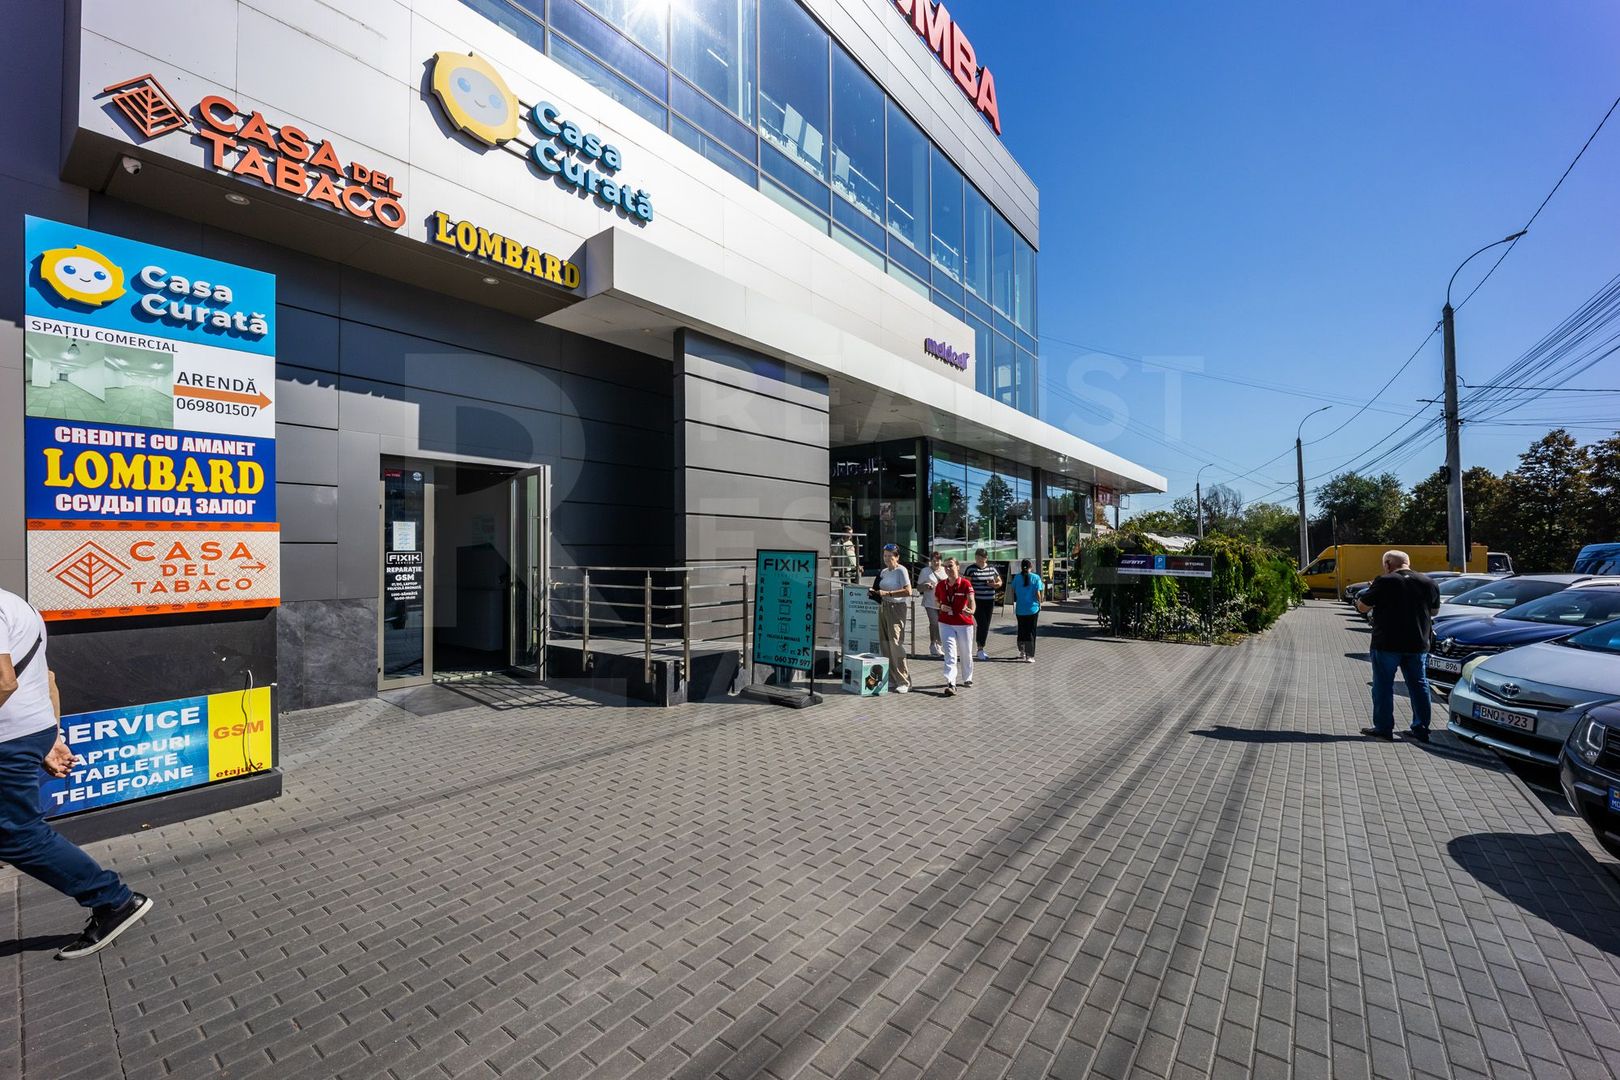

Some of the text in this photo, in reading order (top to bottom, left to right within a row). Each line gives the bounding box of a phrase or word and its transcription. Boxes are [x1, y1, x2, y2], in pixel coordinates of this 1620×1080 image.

[893, 0, 1002, 136] MBA
[200, 95, 403, 199] CASA DEL
[532, 100, 622, 172] Casa
[200, 128, 407, 230] TABACO
[532, 139, 654, 223] Curată
[433, 210, 581, 290] LOMBARD
[140, 265, 234, 304] Casa
[140, 293, 269, 336] Curată
[95, 330, 180, 353] COMERCIAL
[176, 371, 258, 394] ARENDĂ
[176, 397, 258, 418] 069801507
[54, 426, 256, 456] CREDITE CU AMANET
[43, 447, 265, 495] LOMBARD
[55, 493, 256, 515] ССУДЫ ПОД ЗАЛОГ
[129, 541, 254, 562] CASA
[389, 554, 420, 562] FIXIK
[764, 558, 810, 573] FIXIK
[160, 563, 217, 577] DEL
[131, 577, 254, 594] TABACO
[1445, 663, 1458, 671] 896
[213, 720, 264, 740] GSM
[1507, 714, 1528, 728] 923
[75, 735, 191, 766] APTOPURI
[70, 752, 178, 784] TABLETE
[51, 765, 194, 805] TELEFOANE
